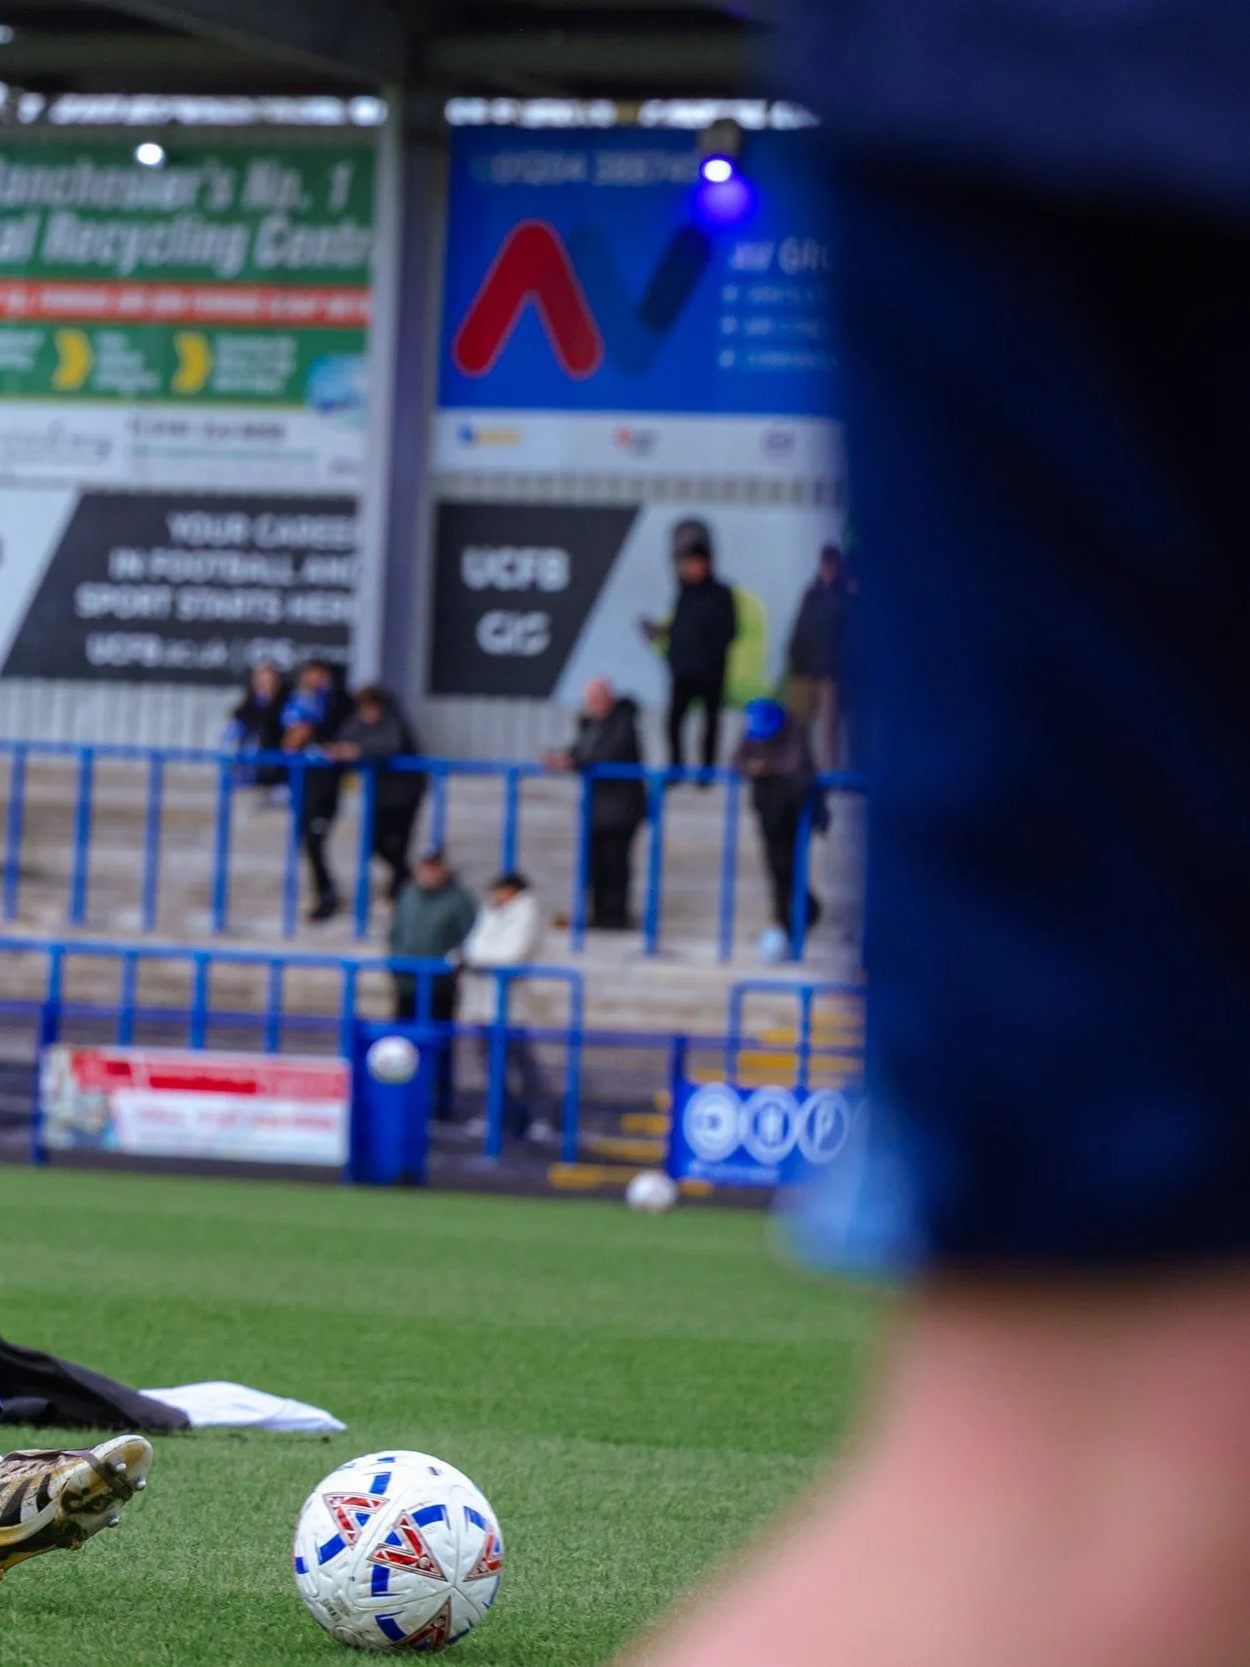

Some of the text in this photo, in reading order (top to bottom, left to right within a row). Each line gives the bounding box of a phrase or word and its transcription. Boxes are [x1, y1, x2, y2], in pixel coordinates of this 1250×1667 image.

[326, 160, 354, 214] 1
[42, 209, 248, 278] Recycling
[253, 214, 373, 271] Centr
[166, 512, 250, 547] YOUR
[108, 546, 146, 581] IN
[149, 547, 293, 585] FOOTBALL
[461, 545, 571, 591] UCFB
[74, 581, 171, 620] SPORT
[174, 585, 283, 624] STARTS
